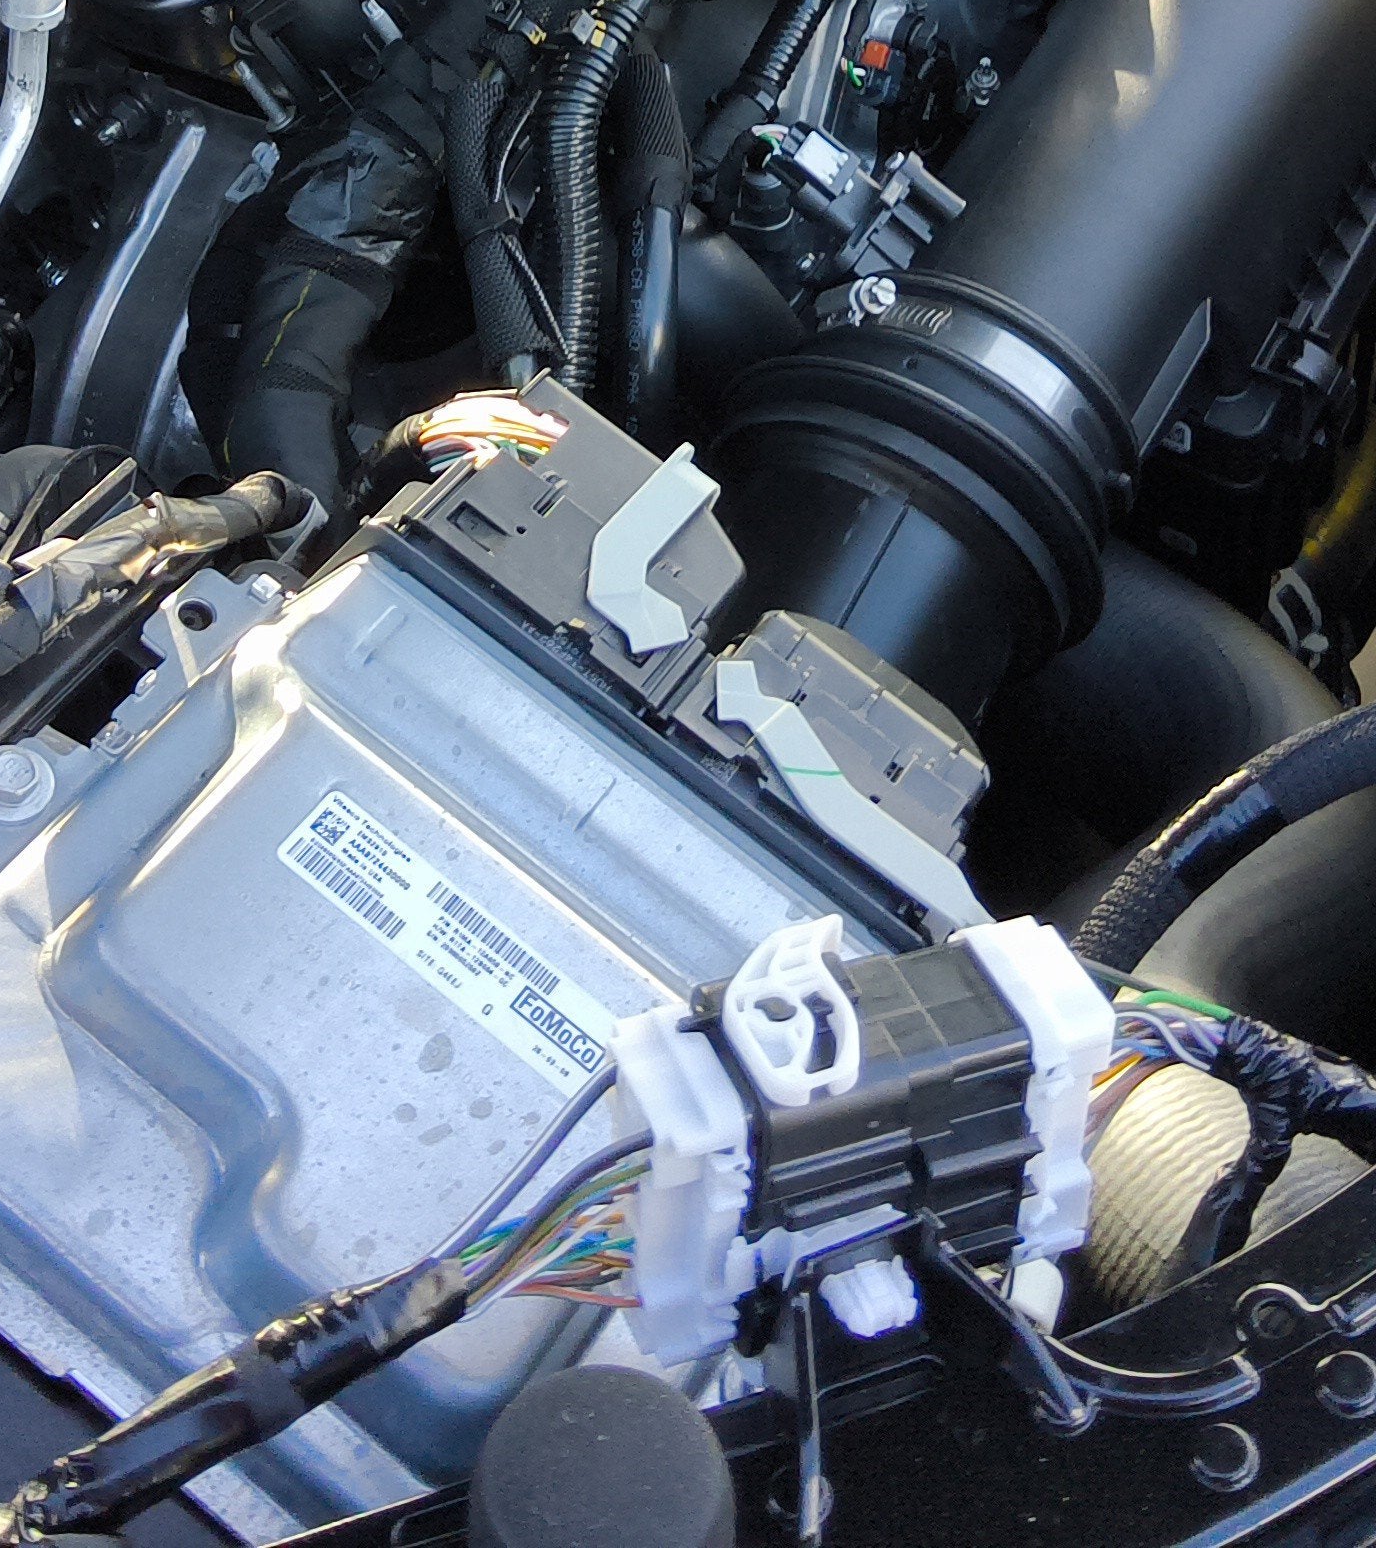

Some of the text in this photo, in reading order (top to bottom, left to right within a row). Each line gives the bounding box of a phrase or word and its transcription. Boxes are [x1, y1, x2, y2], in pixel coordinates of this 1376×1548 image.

[359, 818, 413, 864] Technologies
[340, 846, 360, 864] Made
[367, 868, 383, 883] USA
[516, 991, 600, 1065] FoMoCo
